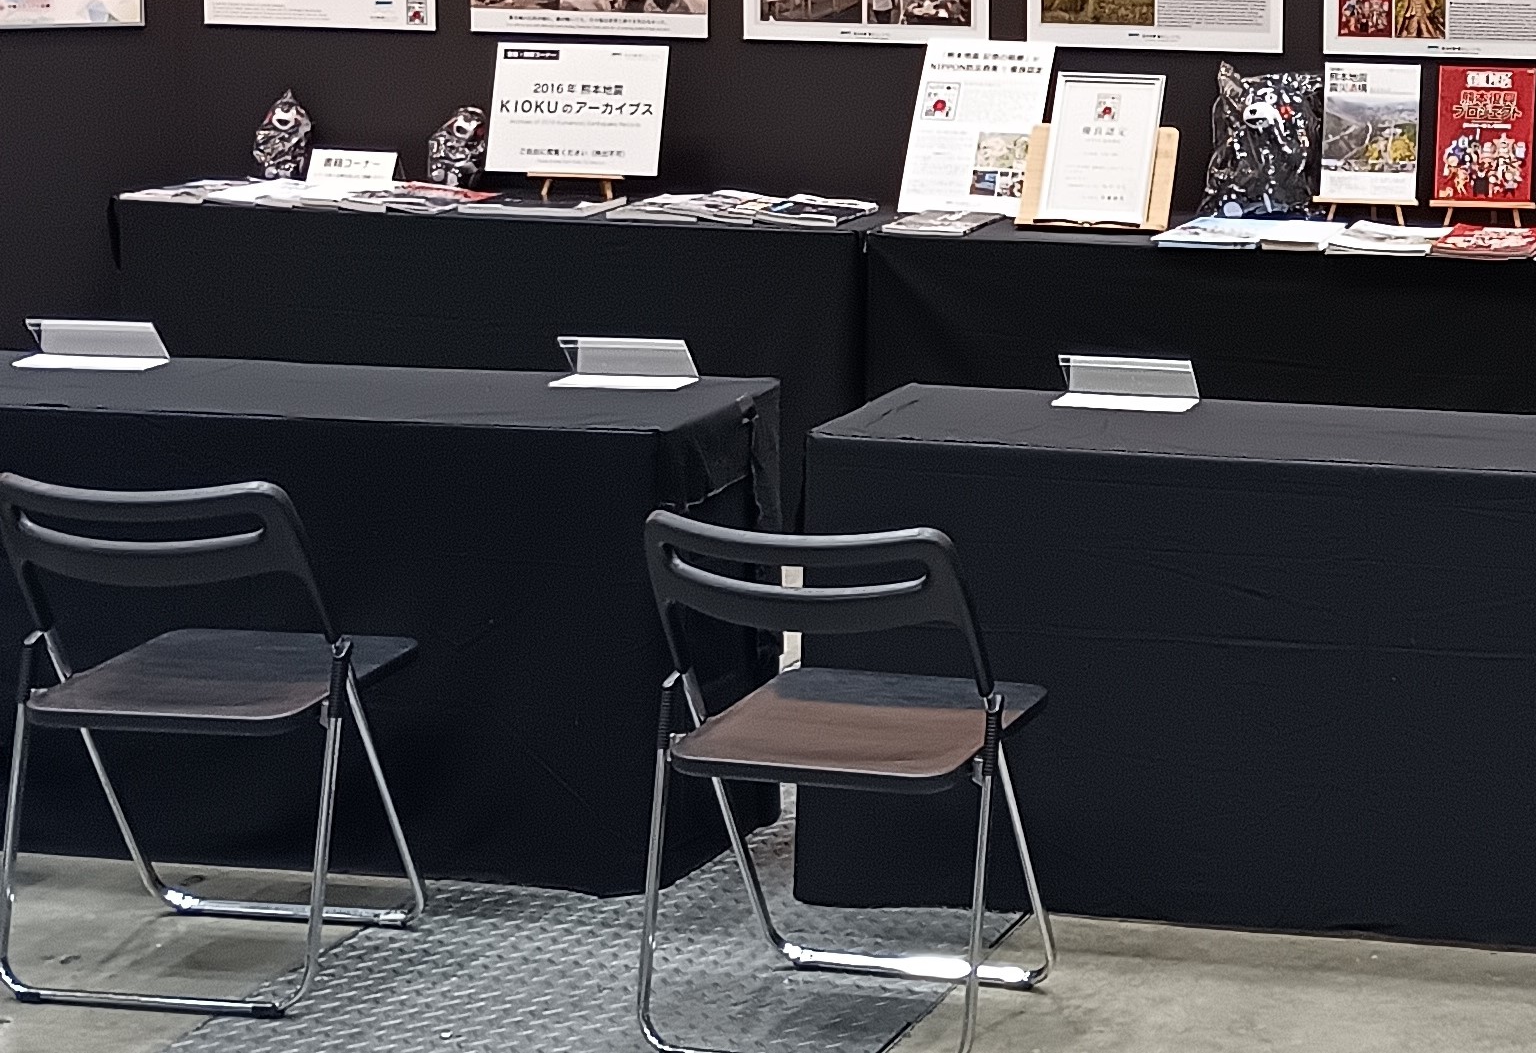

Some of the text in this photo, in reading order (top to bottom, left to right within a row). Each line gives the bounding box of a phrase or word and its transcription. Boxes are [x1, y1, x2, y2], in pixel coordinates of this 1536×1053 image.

[499, 99, 654, 116] KIOKUのアーカイブス
